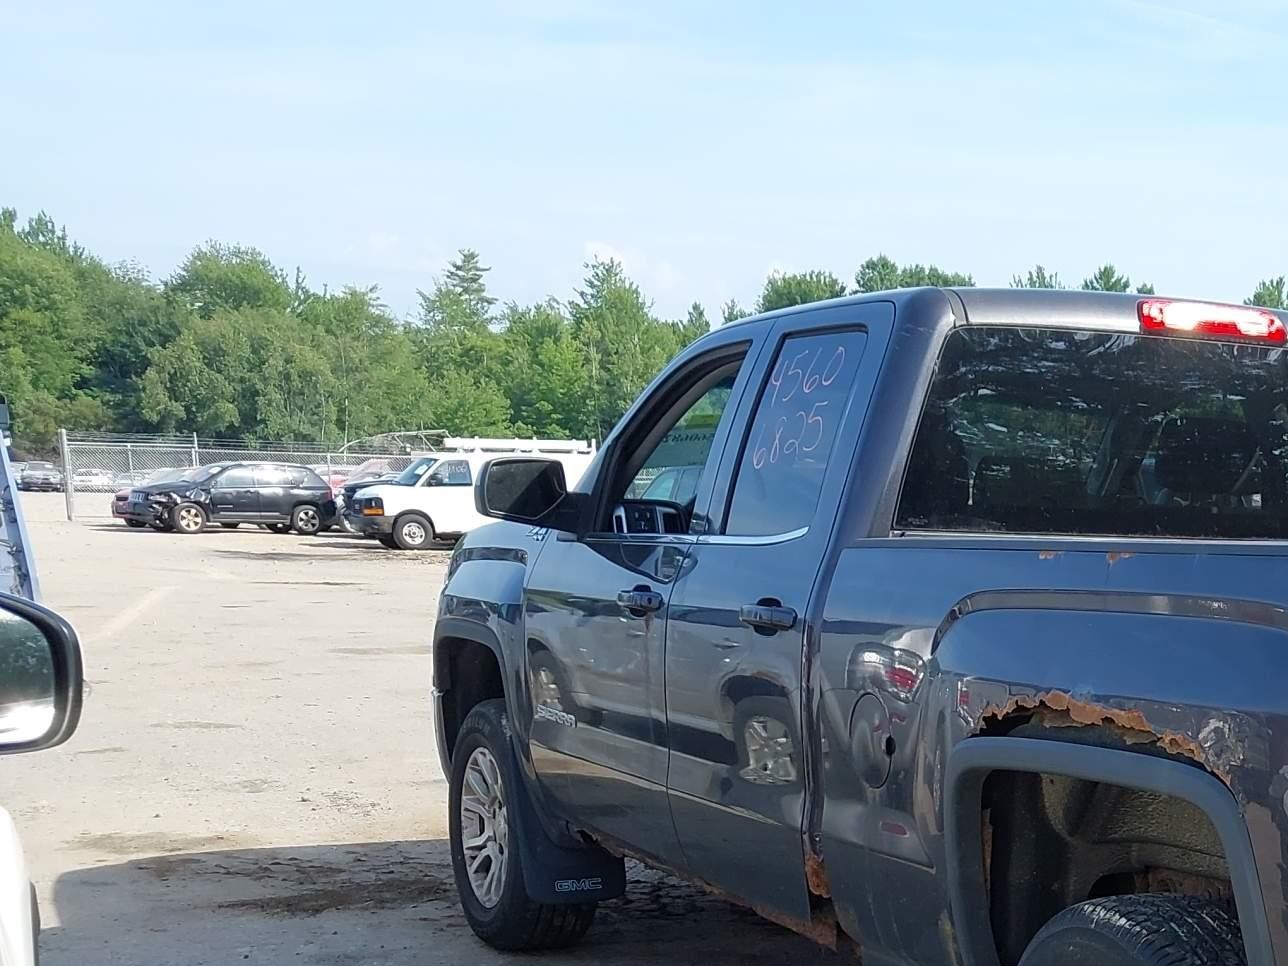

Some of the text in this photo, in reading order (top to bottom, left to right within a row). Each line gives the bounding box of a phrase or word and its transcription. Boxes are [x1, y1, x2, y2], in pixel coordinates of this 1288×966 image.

[771, 346, 845, 408] 4560
[752, 400, 829, 470] 6825
[533, 703, 577, 729] SIERRA
[554, 877, 603, 892] GMC
